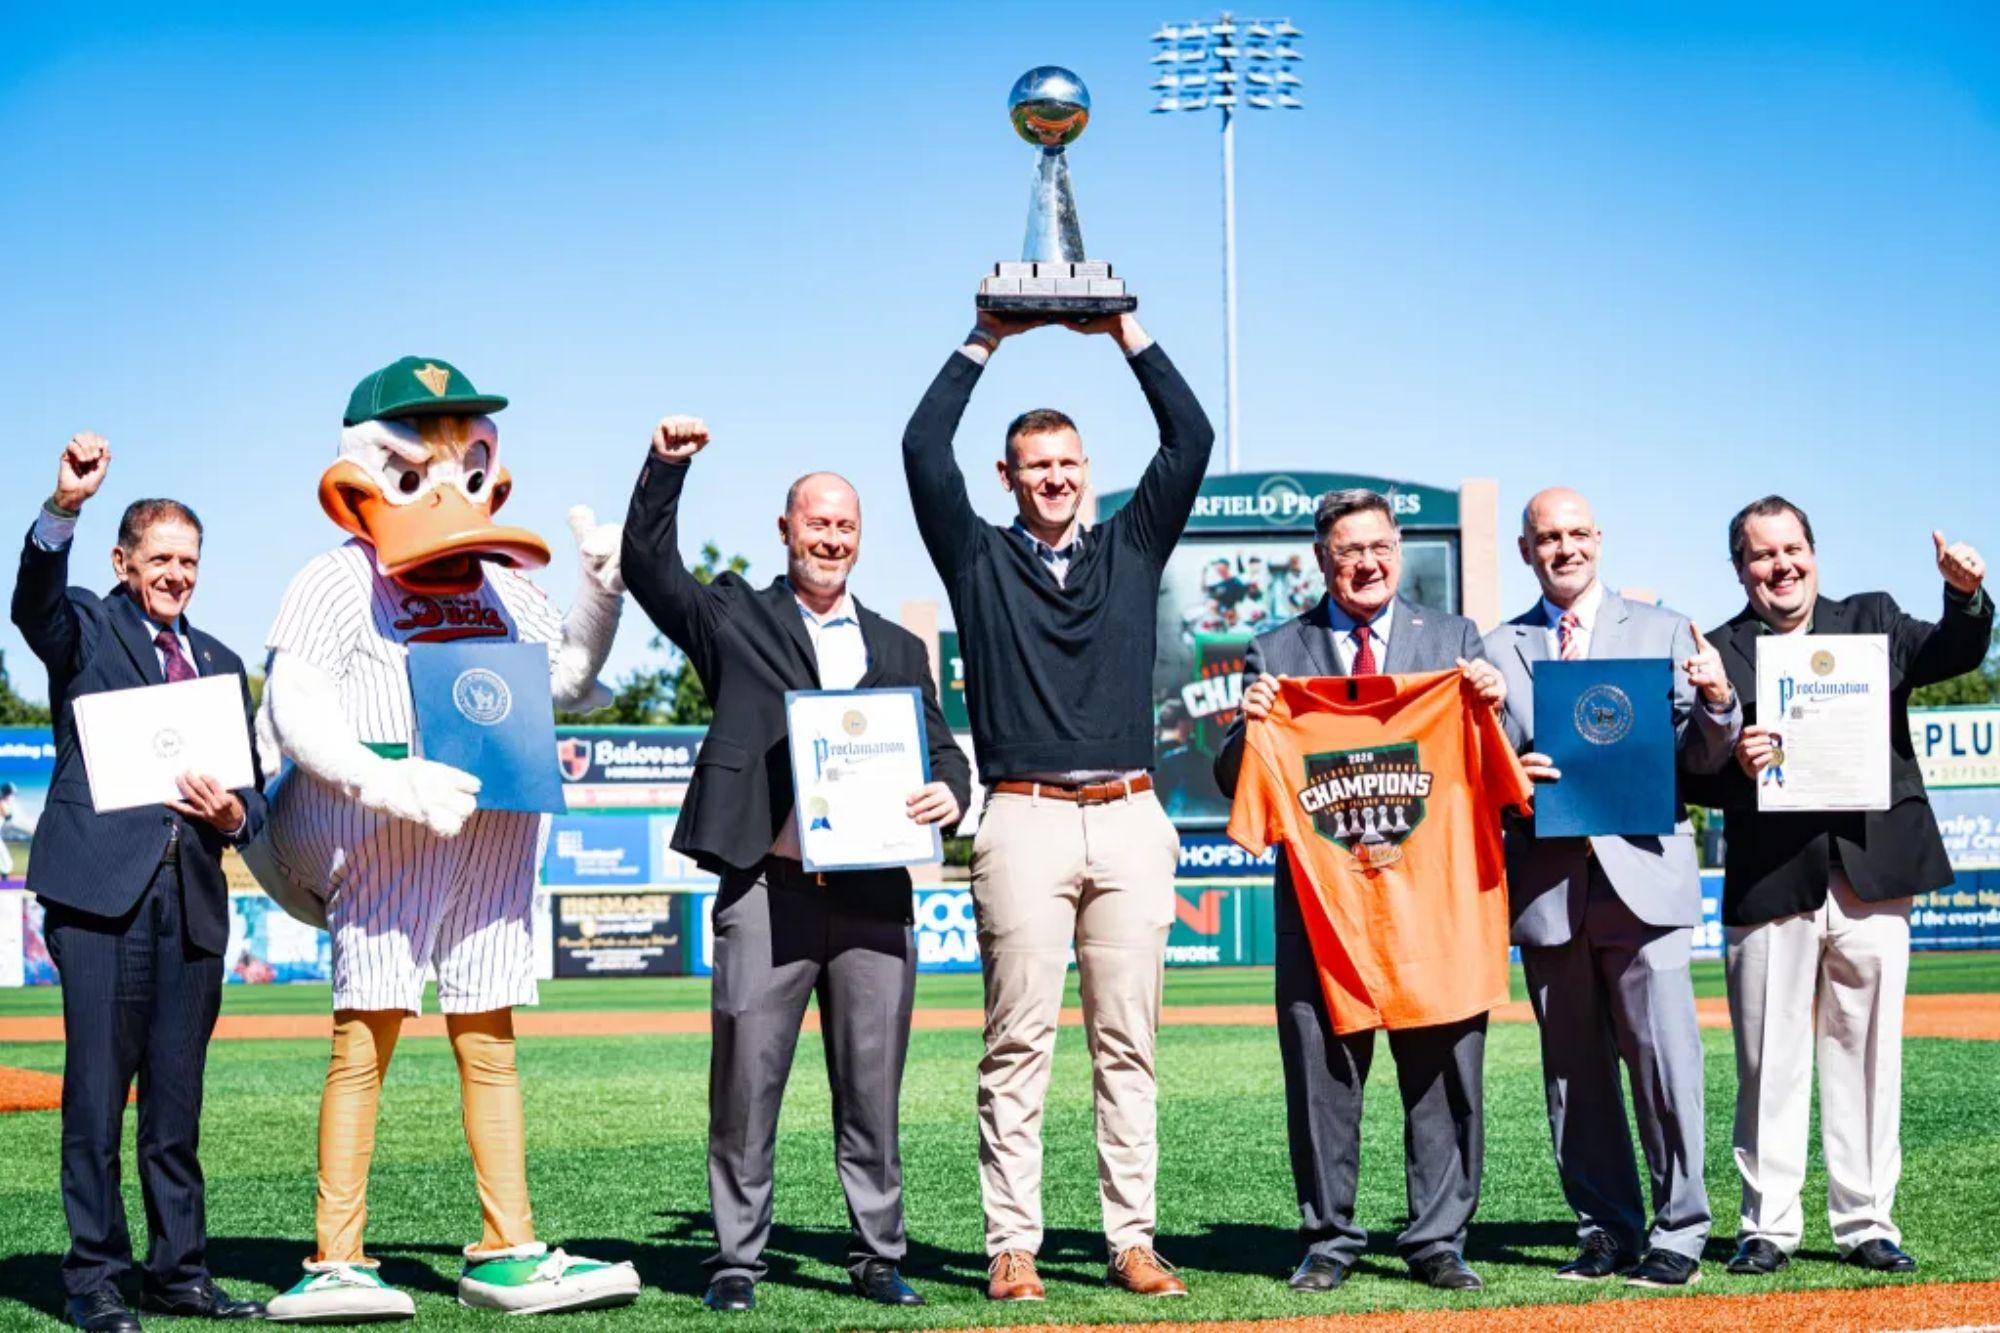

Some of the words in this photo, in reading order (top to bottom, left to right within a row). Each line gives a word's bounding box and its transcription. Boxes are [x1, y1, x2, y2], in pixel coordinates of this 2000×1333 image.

[1778, 676, 1869, 717] Proclamation
[813, 737, 906, 780] Proclamation
[1301, 773, 1430, 812] CHAMPIONS
